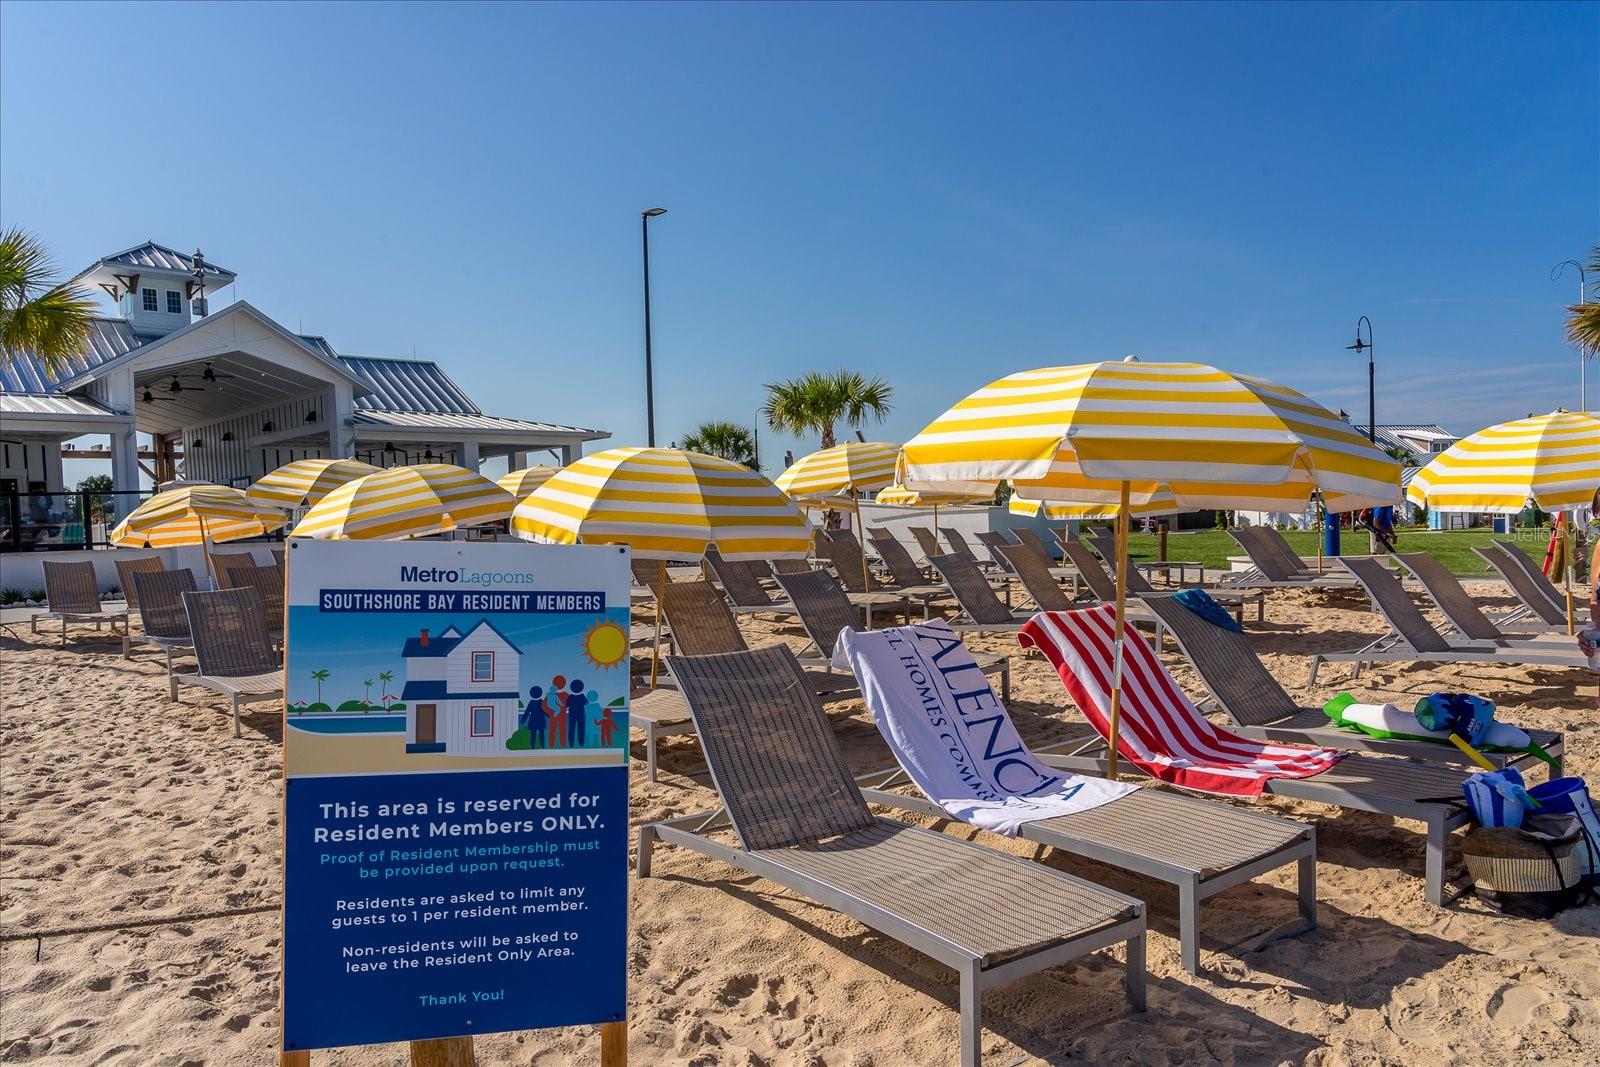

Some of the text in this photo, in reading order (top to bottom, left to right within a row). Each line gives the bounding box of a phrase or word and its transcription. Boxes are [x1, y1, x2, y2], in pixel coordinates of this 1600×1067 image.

[401, 566, 534, 587] MetroLagoons
[324, 594, 600, 610] SOUTHSHORE BAY RESIDENT MEMBERS
[899, 655, 947, 727] HOMES
[320, 793, 599, 819] This area is reserved for
[315, 815, 604, 843] Resident Members ONLY.
[321, 840, 600, 864] Proof of Resident Membership must
[360, 857, 564, 879] be provided upon request.
[337, 887, 585, 911] Residents are asked to limit any
[332, 901, 587, 929] guests to 1 per resident member.
[343, 931, 578, 958] Non-residents will be asked to
[347, 947, 574, 973] leave the Resident Only Area.
[420, 989, 504, 1006] Thank You!
